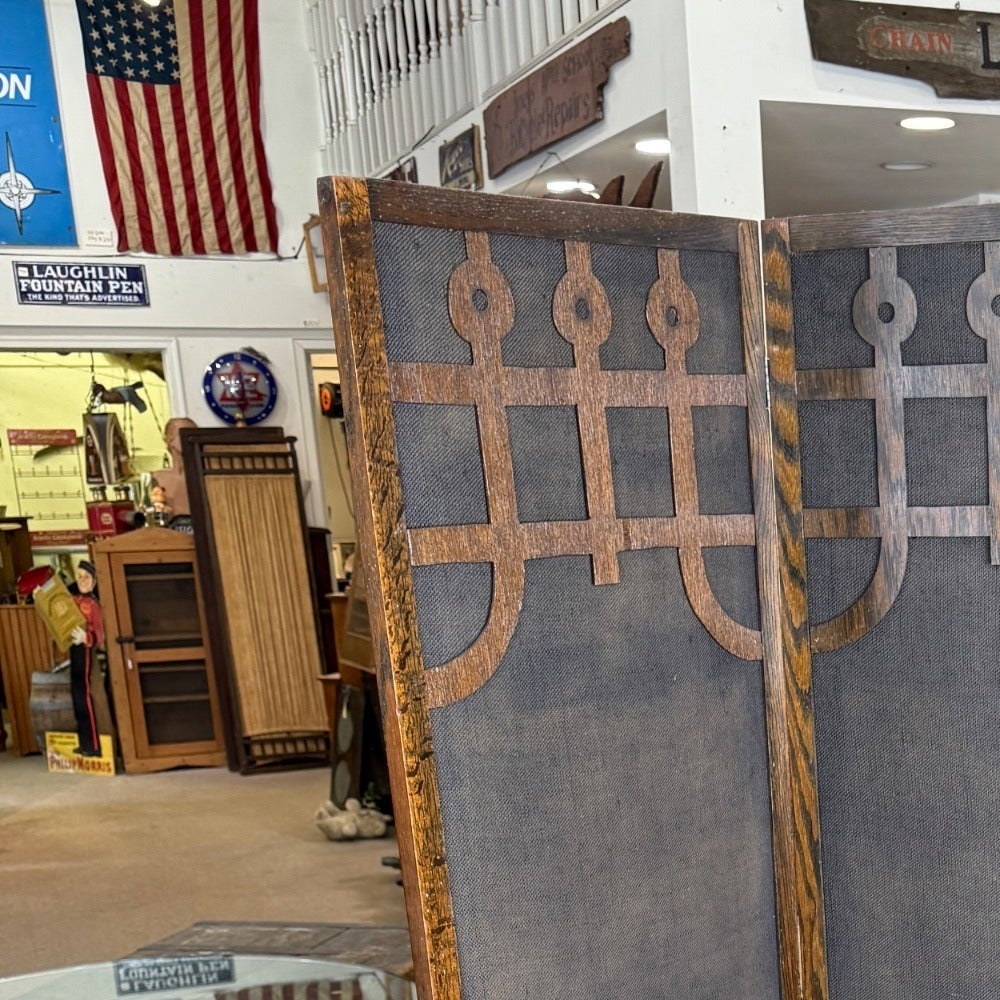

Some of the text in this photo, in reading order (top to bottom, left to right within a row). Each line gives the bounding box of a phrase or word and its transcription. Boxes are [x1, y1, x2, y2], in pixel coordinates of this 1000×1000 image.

[869, 26, 954, 55] CHAIN
[33, 265, 128, 279] LAUGHLIN
[20, 280, 143, 294] FOUNTAIN PEN
